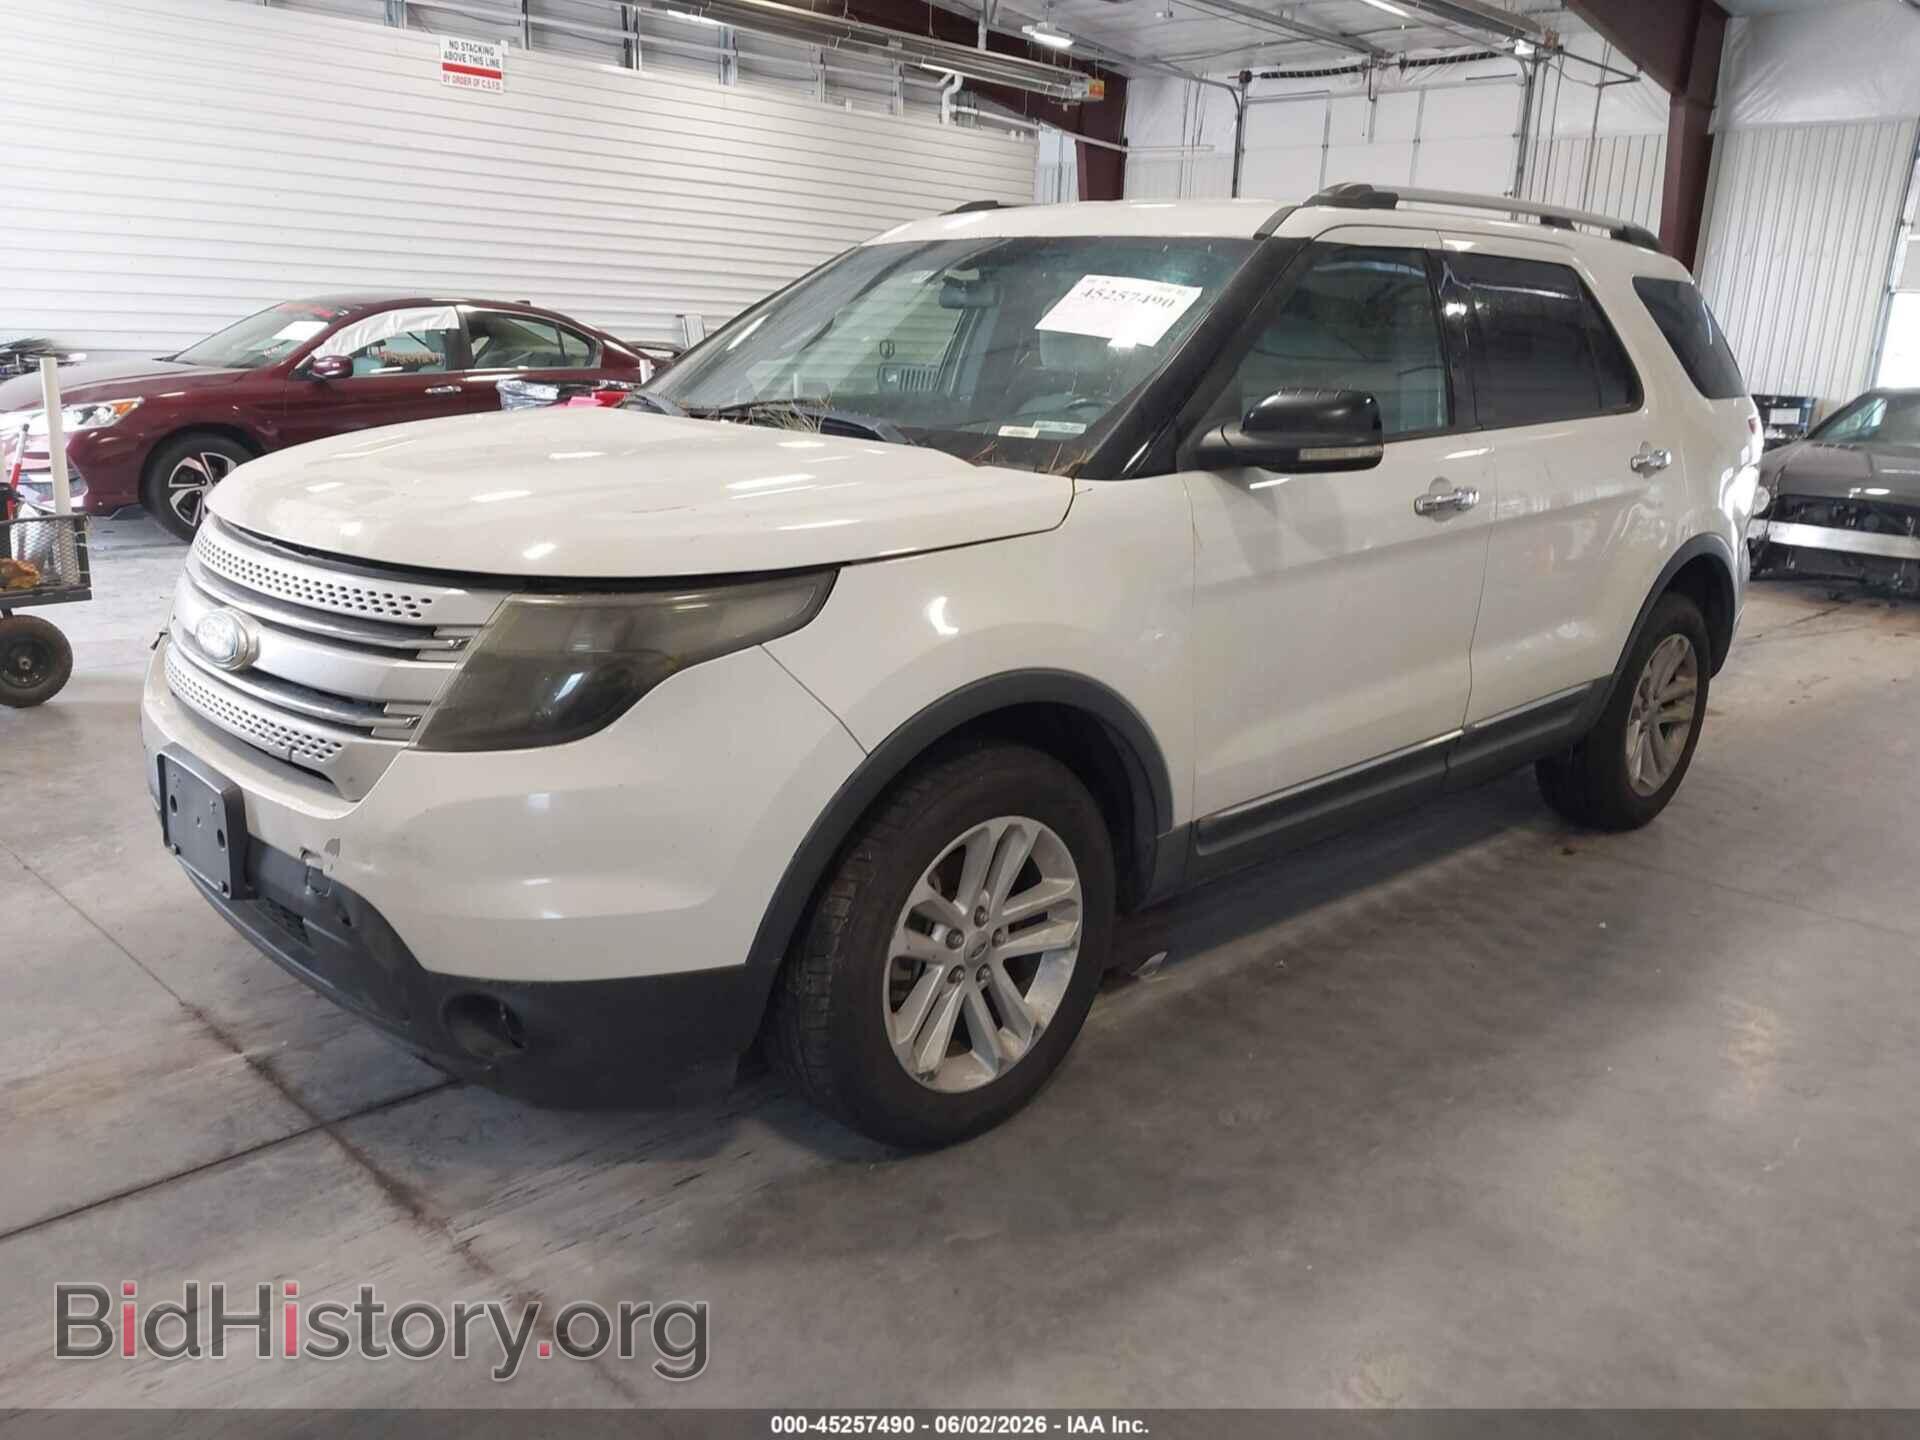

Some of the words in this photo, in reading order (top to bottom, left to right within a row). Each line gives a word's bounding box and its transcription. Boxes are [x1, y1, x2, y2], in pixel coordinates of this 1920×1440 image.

[449, 40, 459, 50] NO
[461, 42, 494, 56] STACKING
[444, 51, 466, 63] ABOVE
[469, 54, 484, 66] THIS
[486, 57, 500, 68] LINE
[1081, 287, 1176, 309] 45257490
